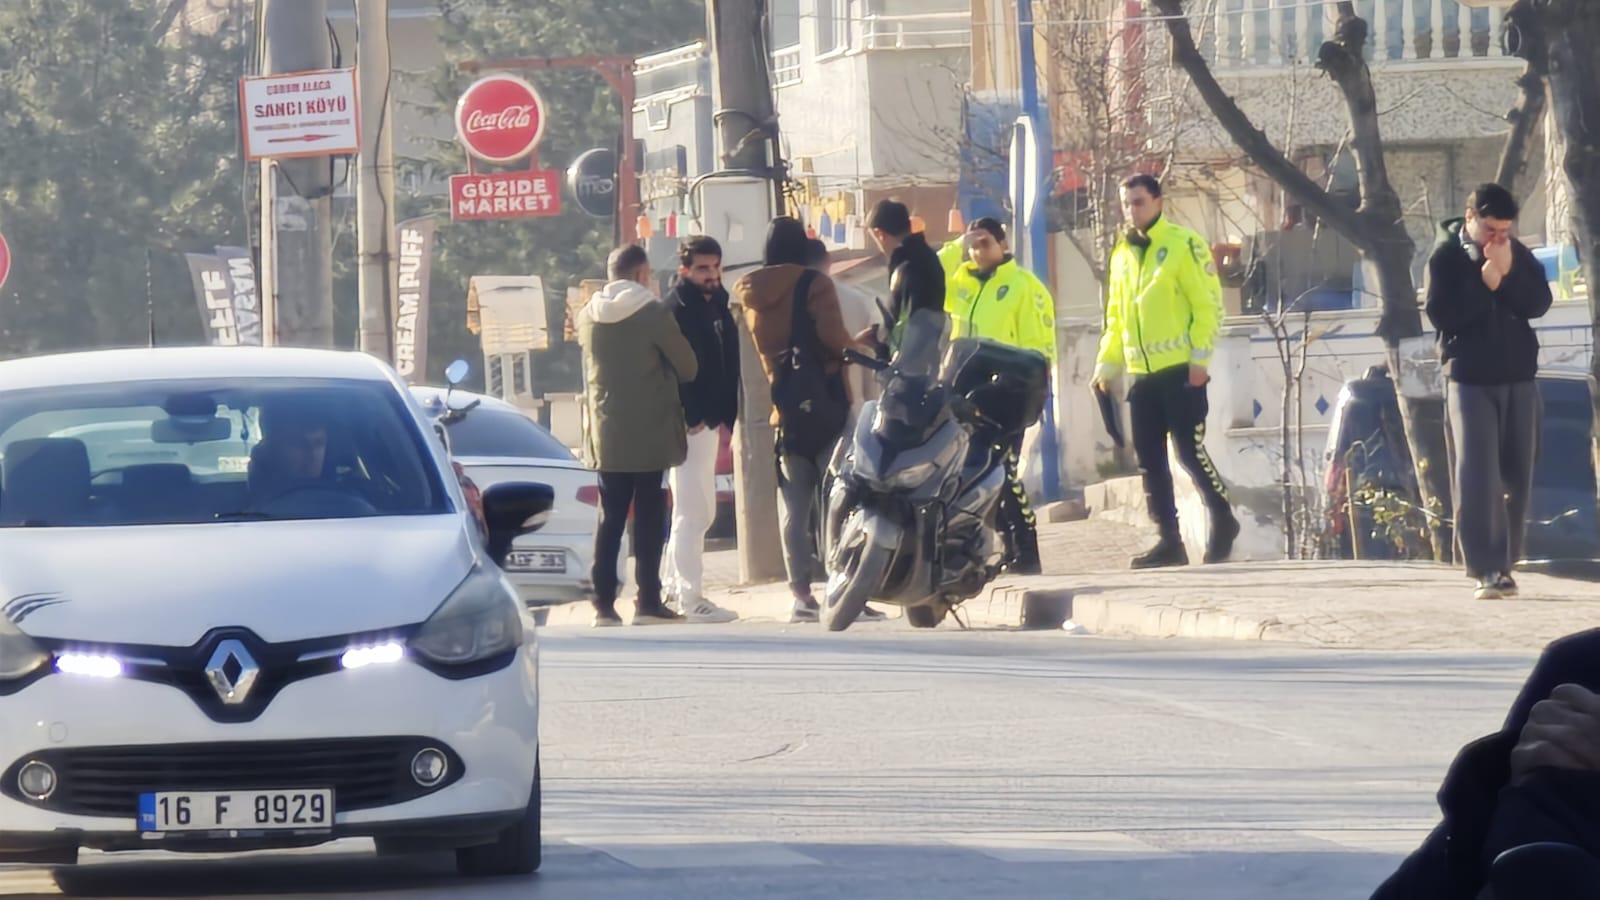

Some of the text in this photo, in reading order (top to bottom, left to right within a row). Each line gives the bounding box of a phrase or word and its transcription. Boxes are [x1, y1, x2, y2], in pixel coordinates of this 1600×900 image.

[306, 95, 346, 114] KÖYÜ
[459, 195, 553, 215] MARKET
[396, 229, 424, 376] CREAM PUFF
[160, 794, 325, 825] 16 F 8929
